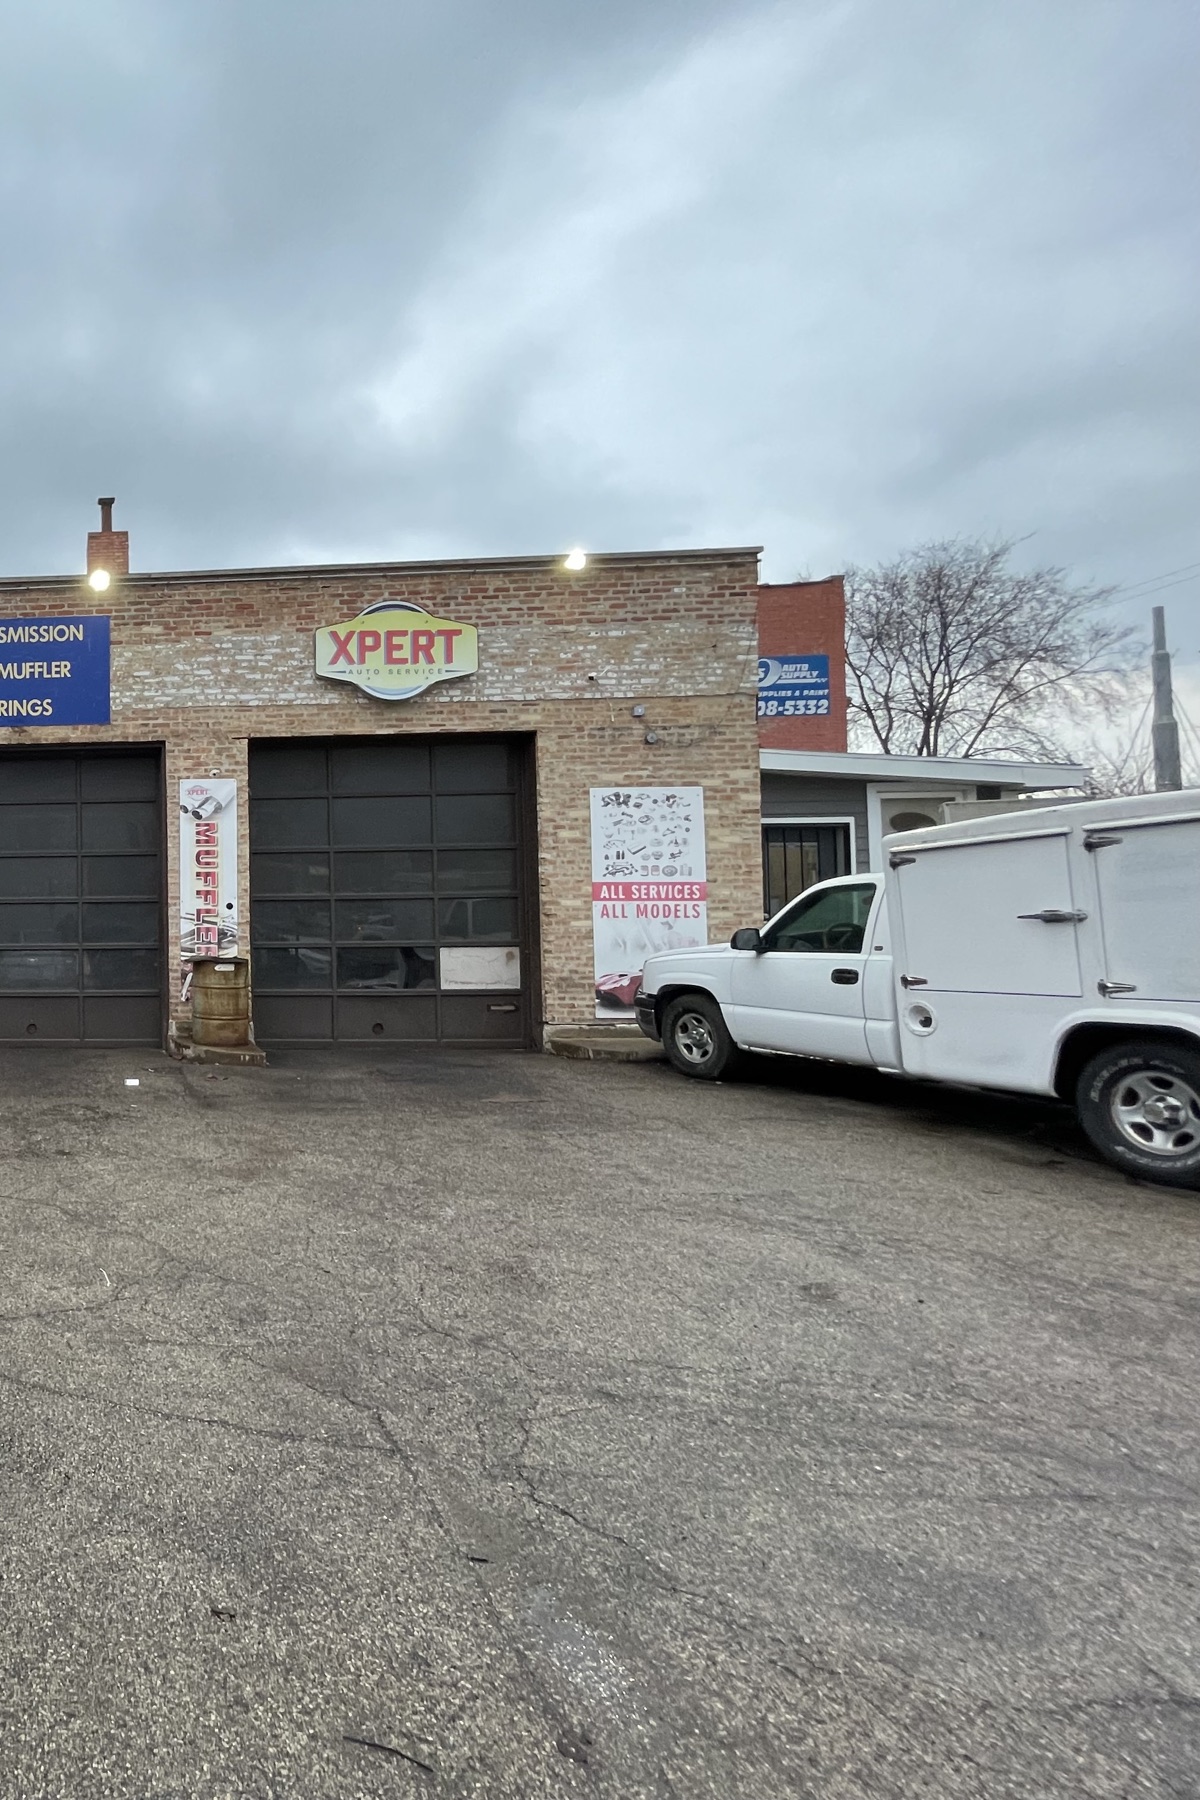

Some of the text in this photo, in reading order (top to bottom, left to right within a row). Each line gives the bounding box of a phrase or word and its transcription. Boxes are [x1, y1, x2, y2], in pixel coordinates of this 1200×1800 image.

[328, 629, 463, 666] XPERT
[388, 667, 443, 675] SERVICE
[782, 664, 809, 672] AUTO
[780, 671, 820, 679] SUPPLY
[600, 885, 700, 899] ALL SERVICES
[601, 903, 700, 919] ALL MODELS
